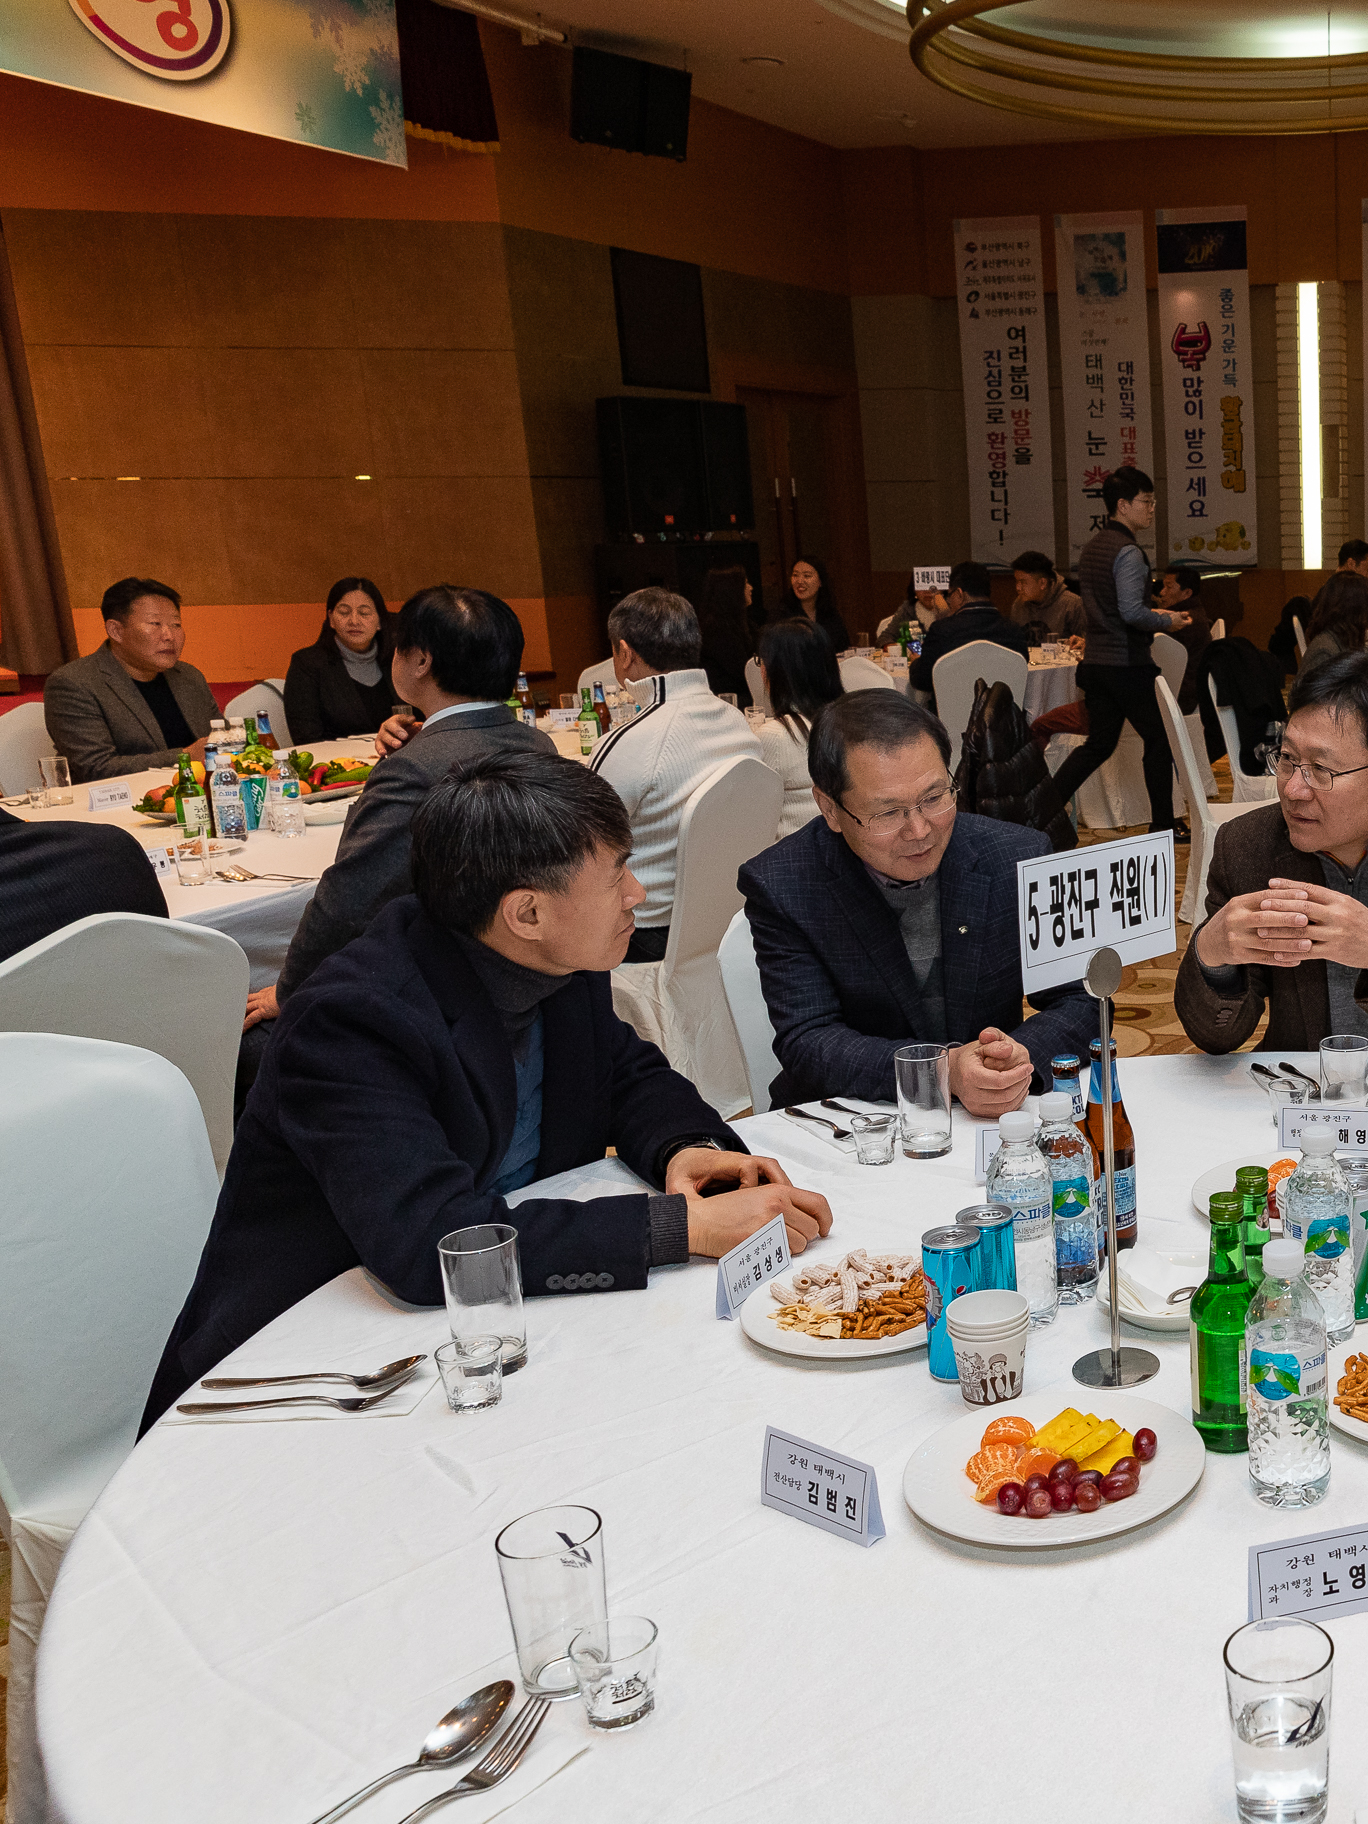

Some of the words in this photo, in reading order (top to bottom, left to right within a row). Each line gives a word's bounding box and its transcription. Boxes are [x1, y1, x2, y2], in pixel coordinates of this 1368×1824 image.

[1217, 287, 1236, 319] 좋은
[1221, 323, 1237, 355] 기운
[1007, 325, 1030, 402] 여러분의
[1222, 358, 1238, 389] 가득
[983, 350, 1006, 425] 진심으로
[1085, 353, 1106, 419] 태백산
[1118, 361, 1136, 421] 대한민국
[1182, 376, 1205, 421] 많이
[1011, 407, 1033, 465] 방문을
[1184, 427, 1209, 519] 받으세요
[1028, 868, 1100, 951] 5-광진구
[1109, 851, 1168, 930] 직원(1)
[1299, 1113, 1319, 1122] 서울
[1322, 1114, 1352, 1123] 광진구
[1013, 1203, 1051, 1221] 스파클
[738, 1253, 752, 1268] 서울
[753, 1236, 774, 1256] 광진구
[787, 1453, 809, 1470] 강원
[813, 1463, 846, 1486] 태백시
[773, 1471, 802, 1491] 전산담당
[807, 1480, 857, 1521] 김범진
[1285, 1553, 1316, 1570] 강원
[1267, 1576, 1313, 1594] 자치행정
